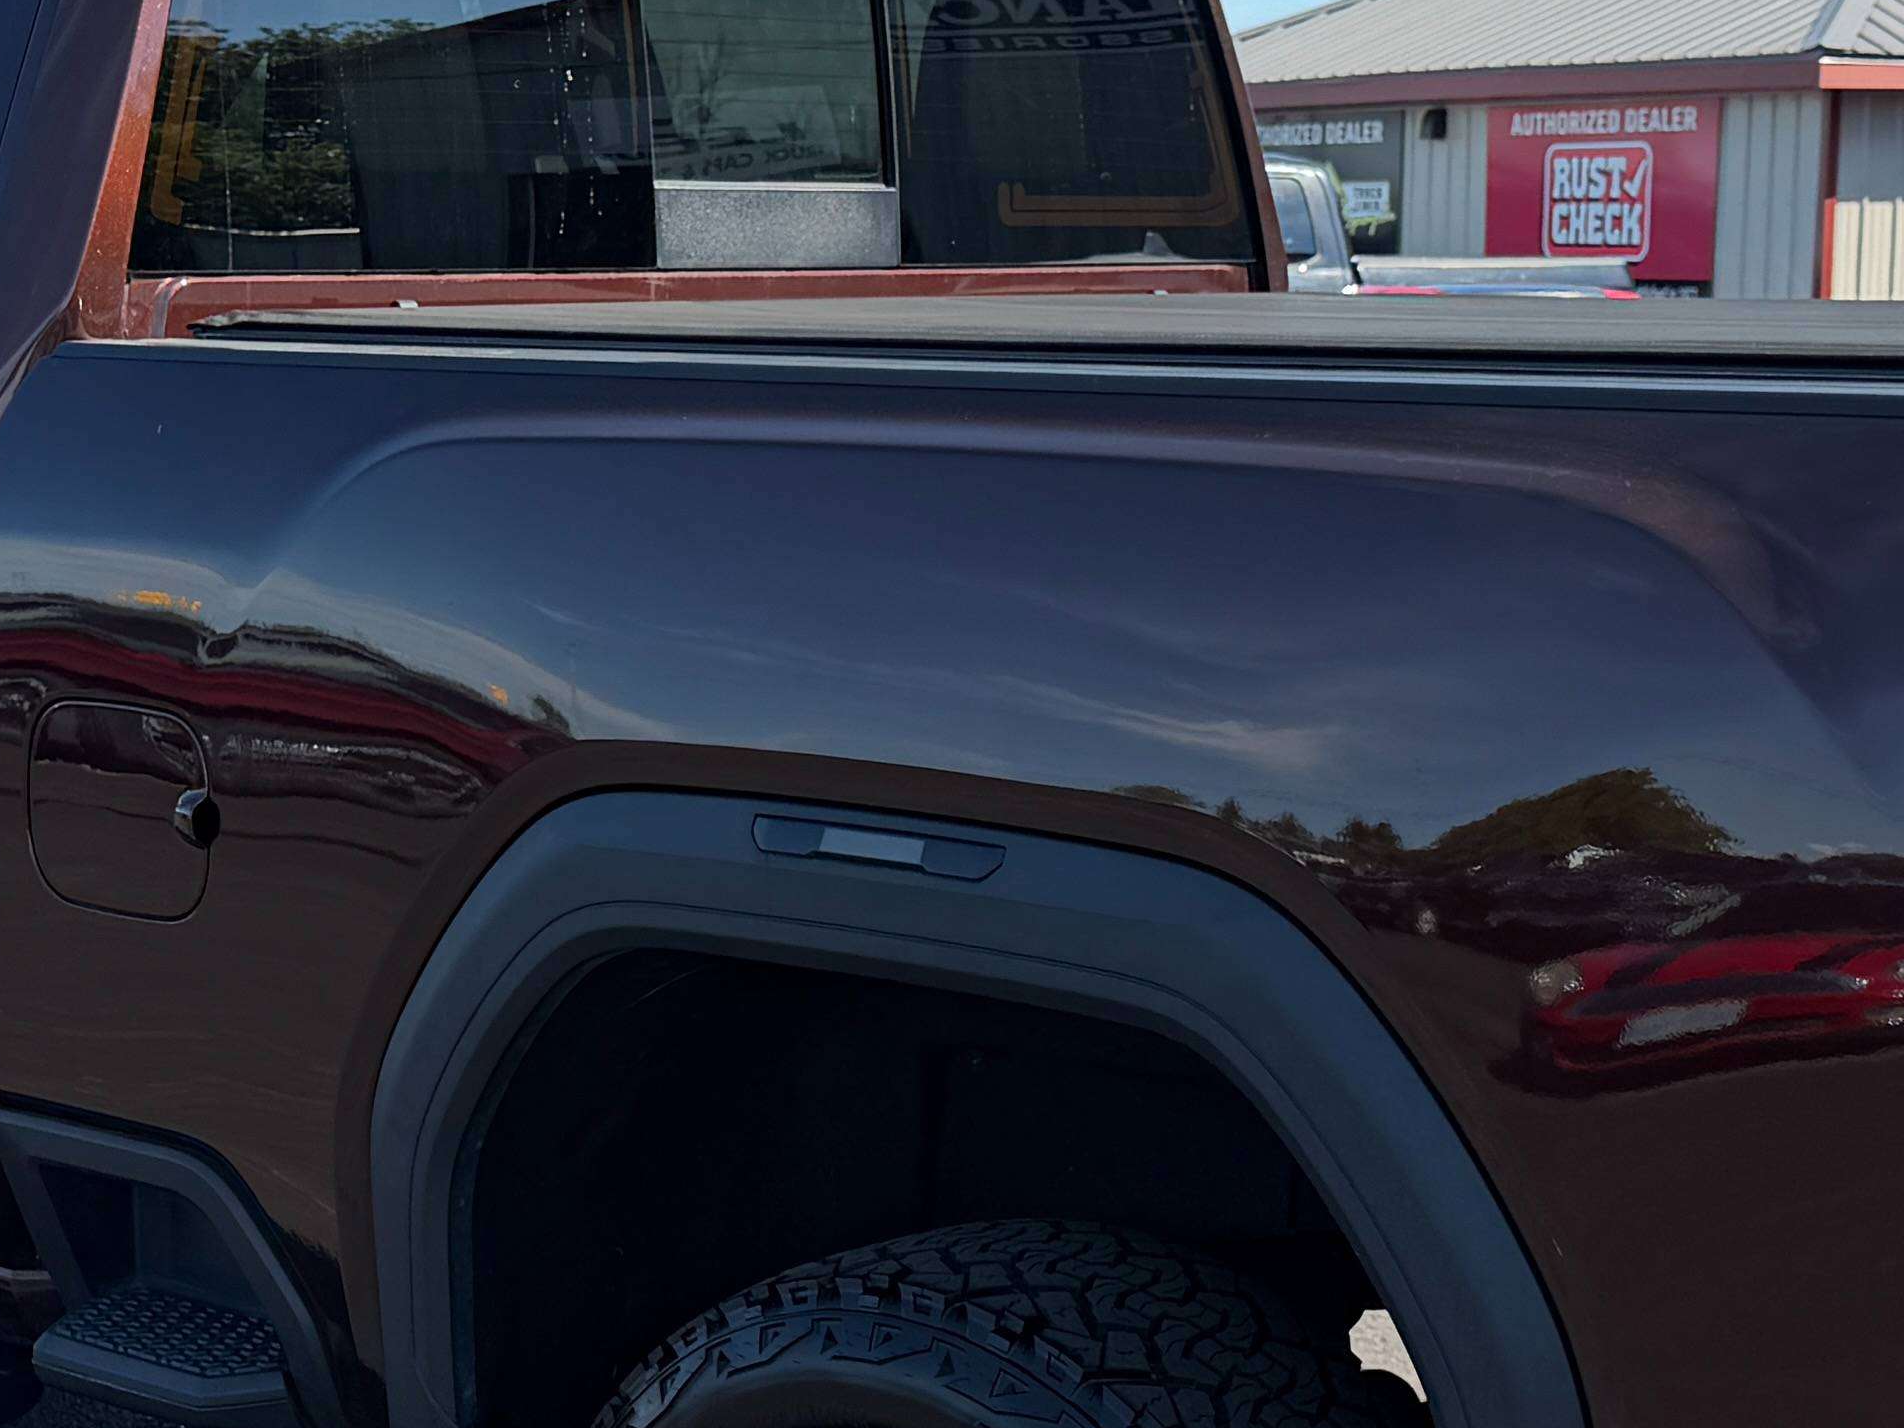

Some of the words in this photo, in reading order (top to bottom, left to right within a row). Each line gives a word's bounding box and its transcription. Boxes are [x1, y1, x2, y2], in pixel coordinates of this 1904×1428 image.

[1325, 120, 1384, 145] DEALER
[1510, 108, 1621, 136] AUTHORIZED
[1624, 105, 1698, 133] DEALER
[1553, 157, 1627, 201] RUST
[1551, 202, 1644, 248] CHECK
